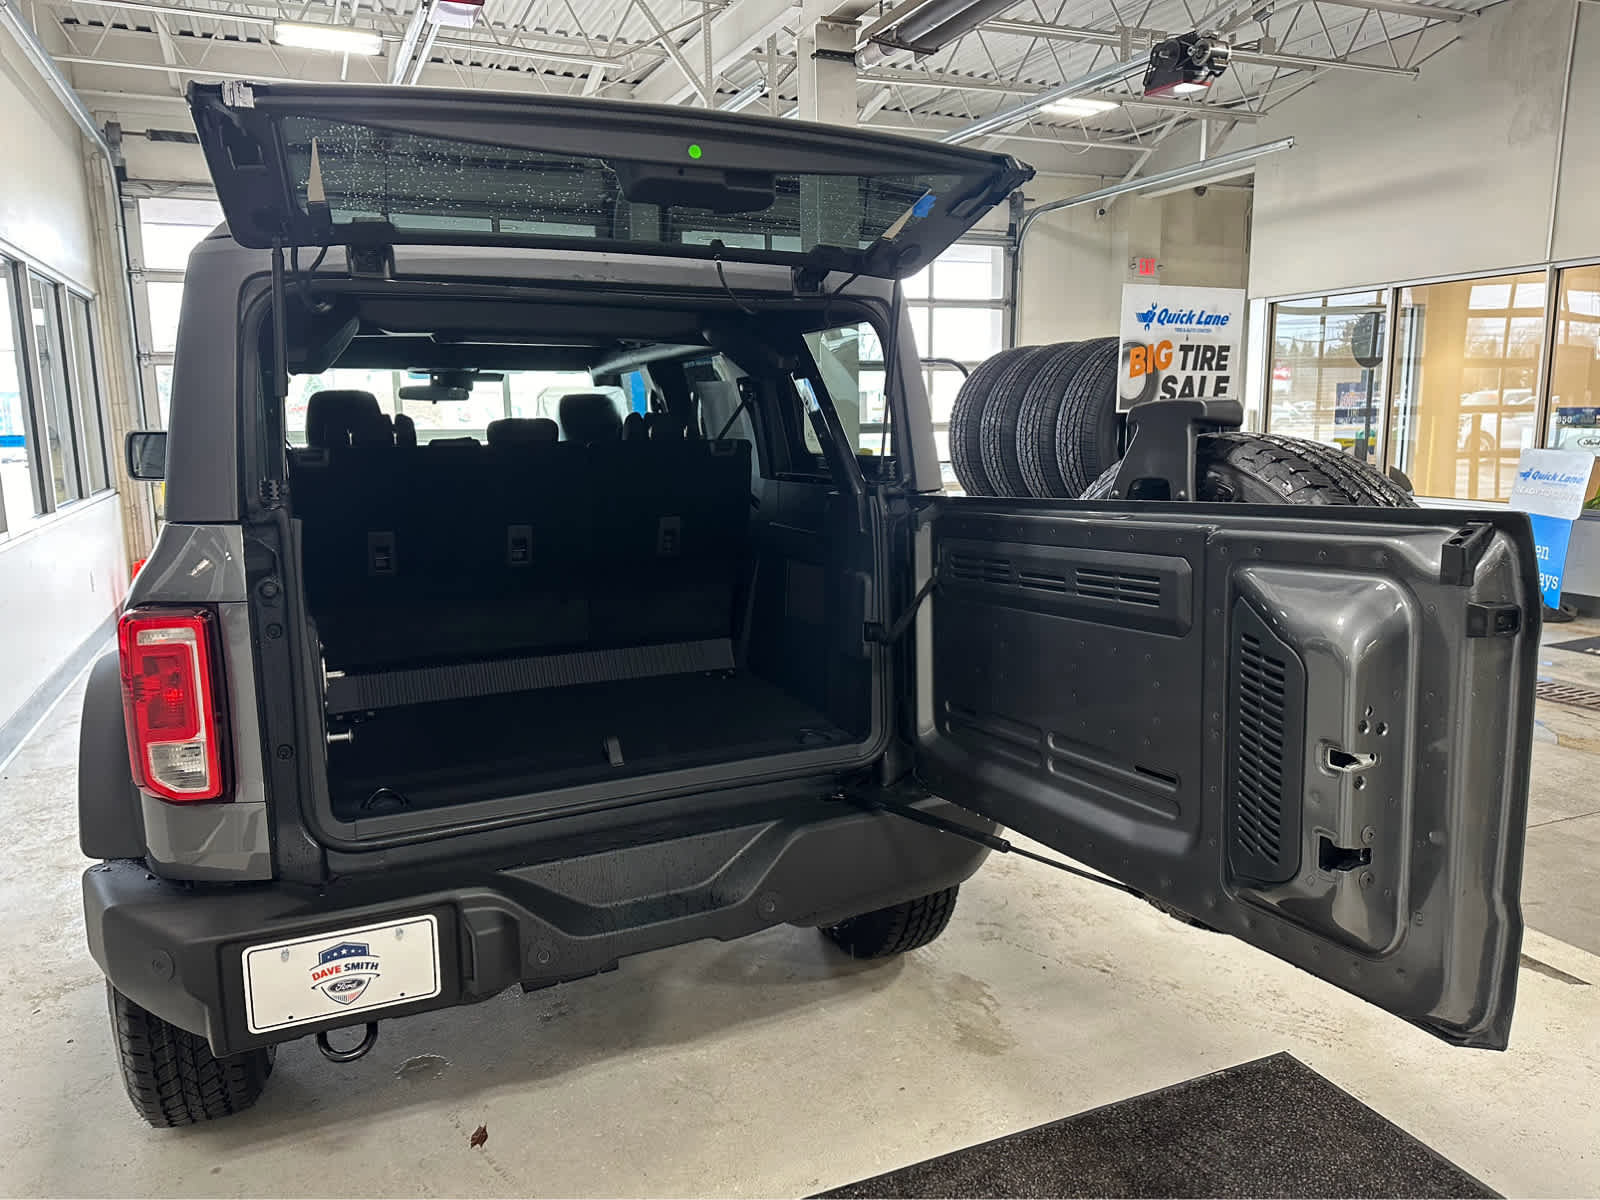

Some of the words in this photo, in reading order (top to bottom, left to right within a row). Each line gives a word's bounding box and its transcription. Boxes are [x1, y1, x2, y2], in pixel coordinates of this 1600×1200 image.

[1139, 258, 1156, 275] EXIT
[1157, 308, 1196, 326] Quick
[1196, 310, 1230, 326] Lane
[1129, 340, 1173, 379] BIG
[1179, 344, 1231, 371] TIRE
[1531, 470, 1559, 482] Quick
[1559, 472, 1585, 484] Lane
[1535, 545, 1549, 560] en
[1539, 572, 1559, 592] ays
[311, 964, 342, 981] DAVE
[344, 961, 379, 972] SMITH
